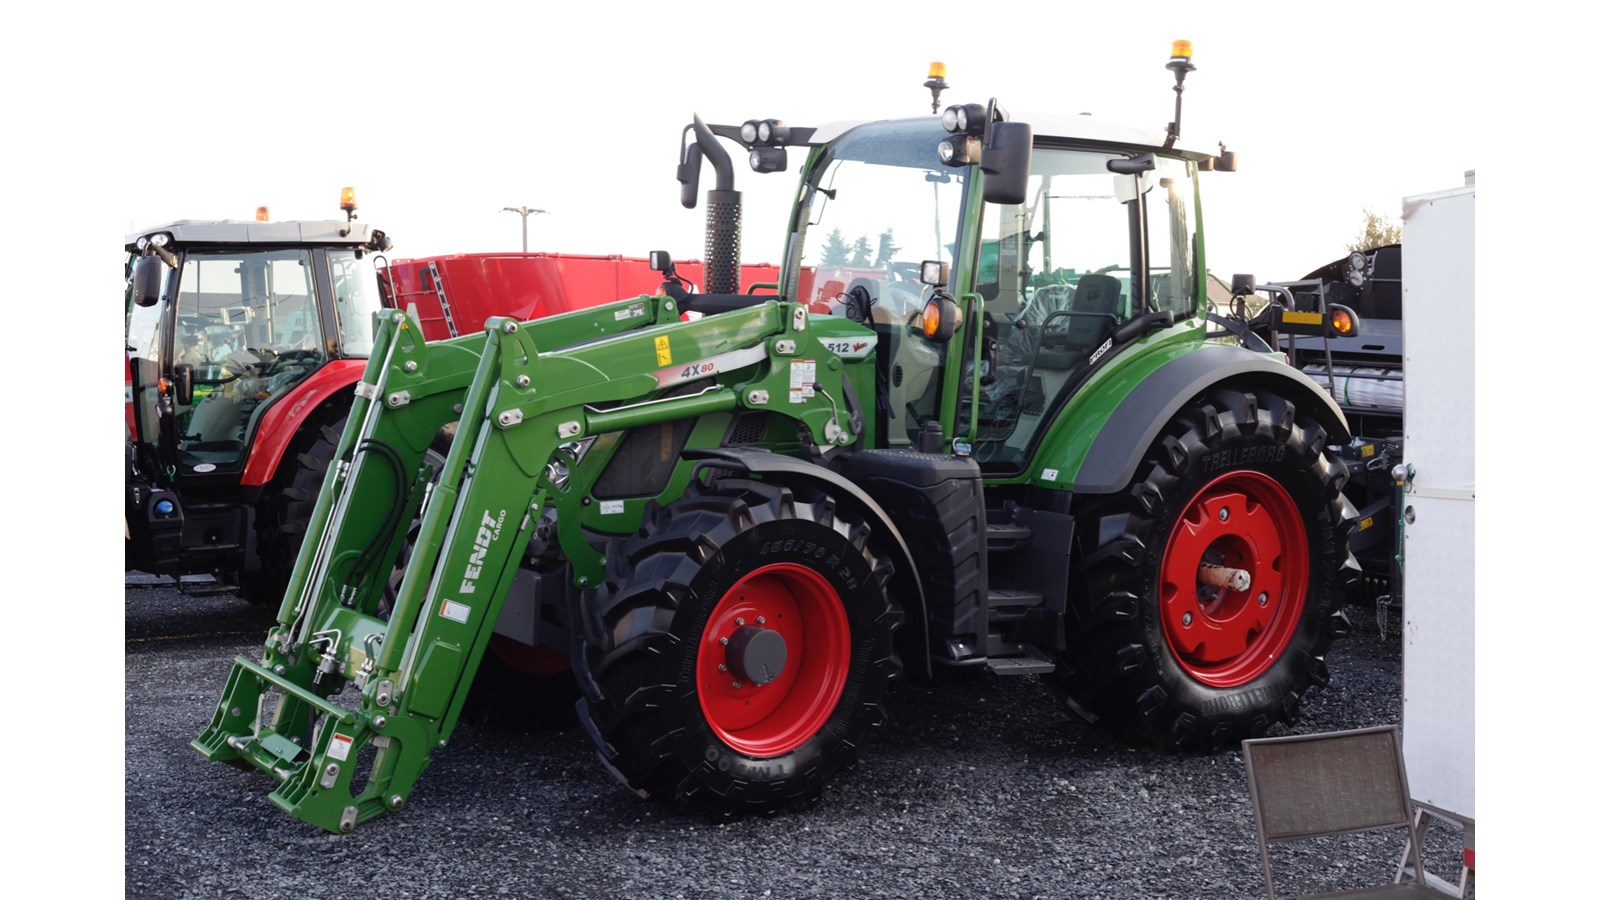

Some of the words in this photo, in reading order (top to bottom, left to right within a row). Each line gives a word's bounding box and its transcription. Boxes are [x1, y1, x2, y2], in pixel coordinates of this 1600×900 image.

[828, 342, 850, 353] 512
[1090, 339, 1112, 363] PROFI
[1202, 445, 1286, 471] TRELLEBORG
[492, 509, 507, 542] CARGO
[459, 509, 497, 594] FENDT
[826, 553, 841, 569] R
[838, 566, 858, 590] 28
